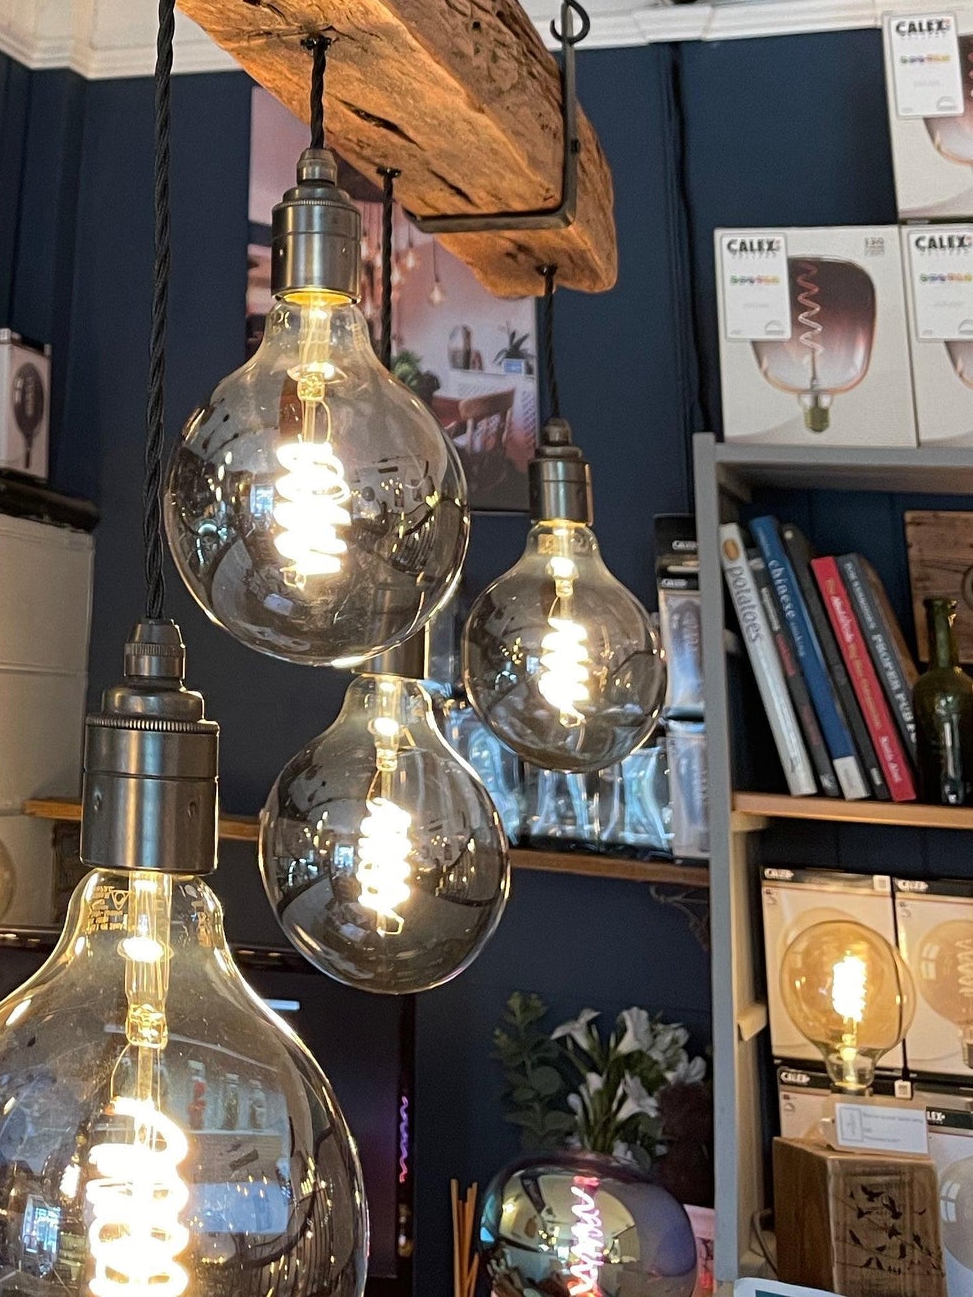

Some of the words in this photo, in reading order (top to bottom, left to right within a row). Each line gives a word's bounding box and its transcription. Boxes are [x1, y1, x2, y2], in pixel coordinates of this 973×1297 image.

[895, 19, 945, 35] CALEX
[727, 238, 775, 253] CALEX
[915, 235, 965, 250] CALEX
[727, 566, 762, 643] potatoes
[768, 560, 796, 618] chinese
[871, 634, 902, 690] PROPER
